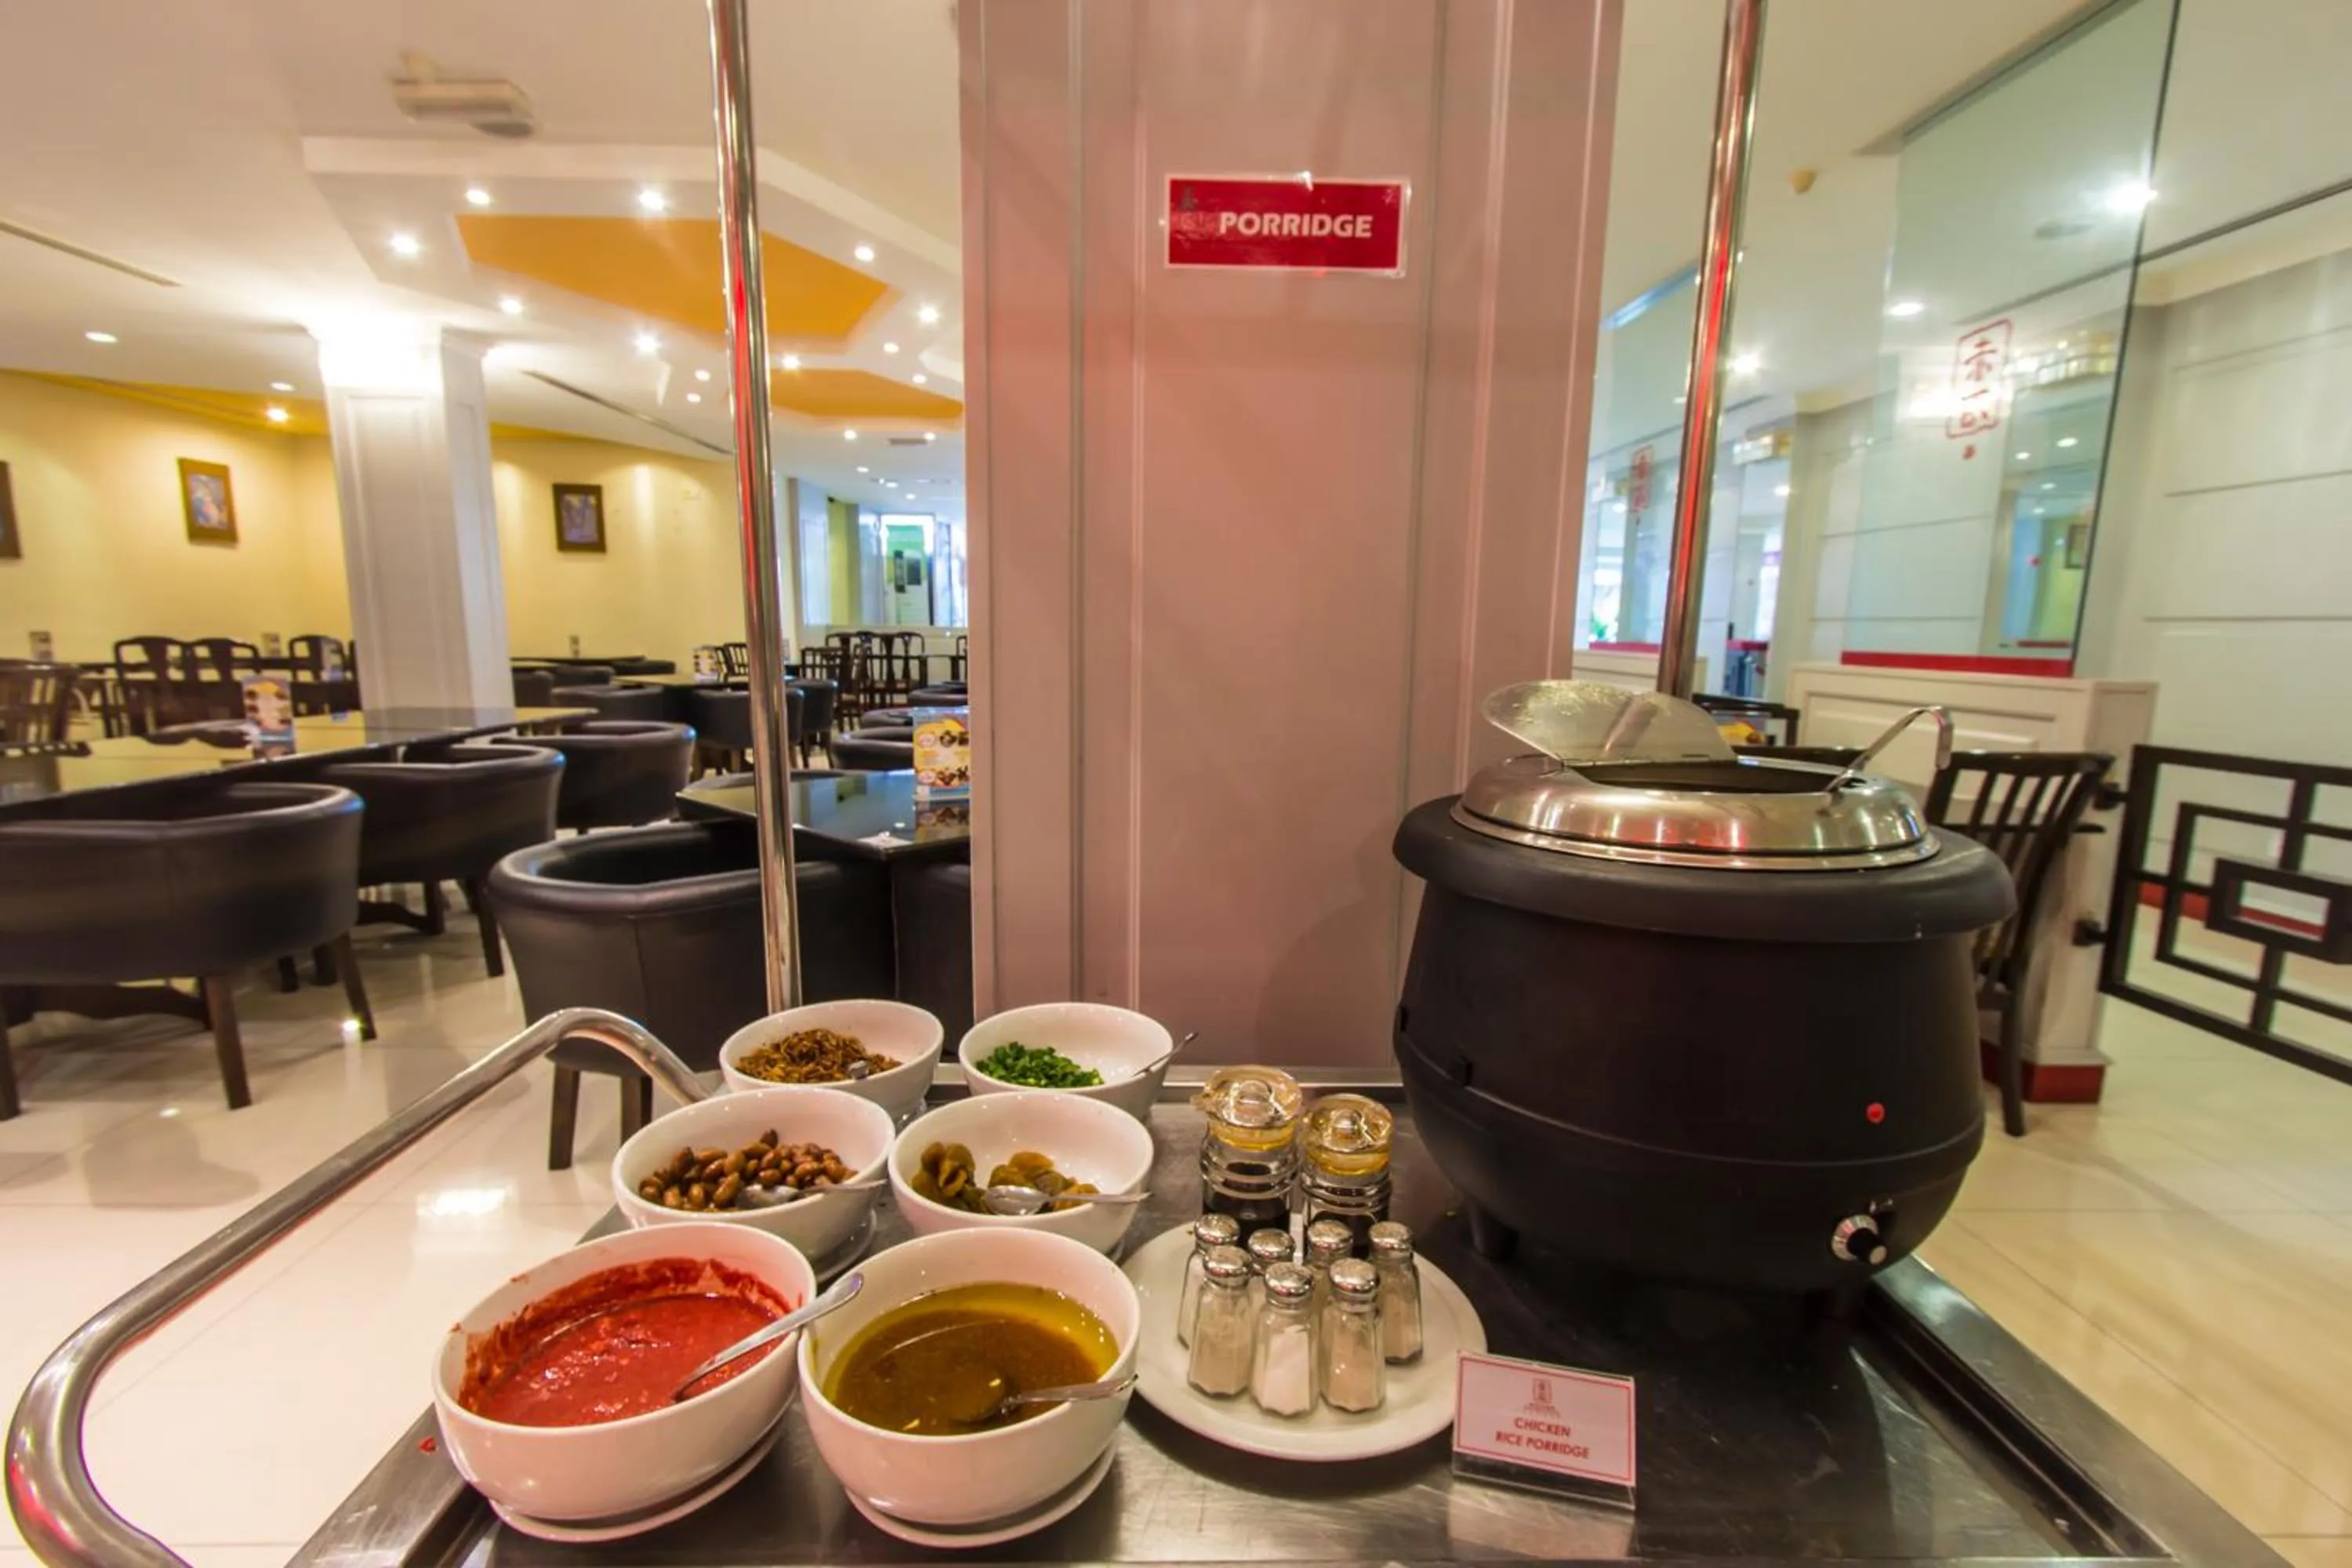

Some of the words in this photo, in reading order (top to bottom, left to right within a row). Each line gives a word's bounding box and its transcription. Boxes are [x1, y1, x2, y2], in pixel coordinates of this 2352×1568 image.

[1218, 211, 1374, 238] PORRIDGE
[1514, 1417, 1571, 1437] CHICKEN
[1496, 1431, 1522, 1446] RICE
[1526, 1437, 1589, 1459] PORRIDGE
